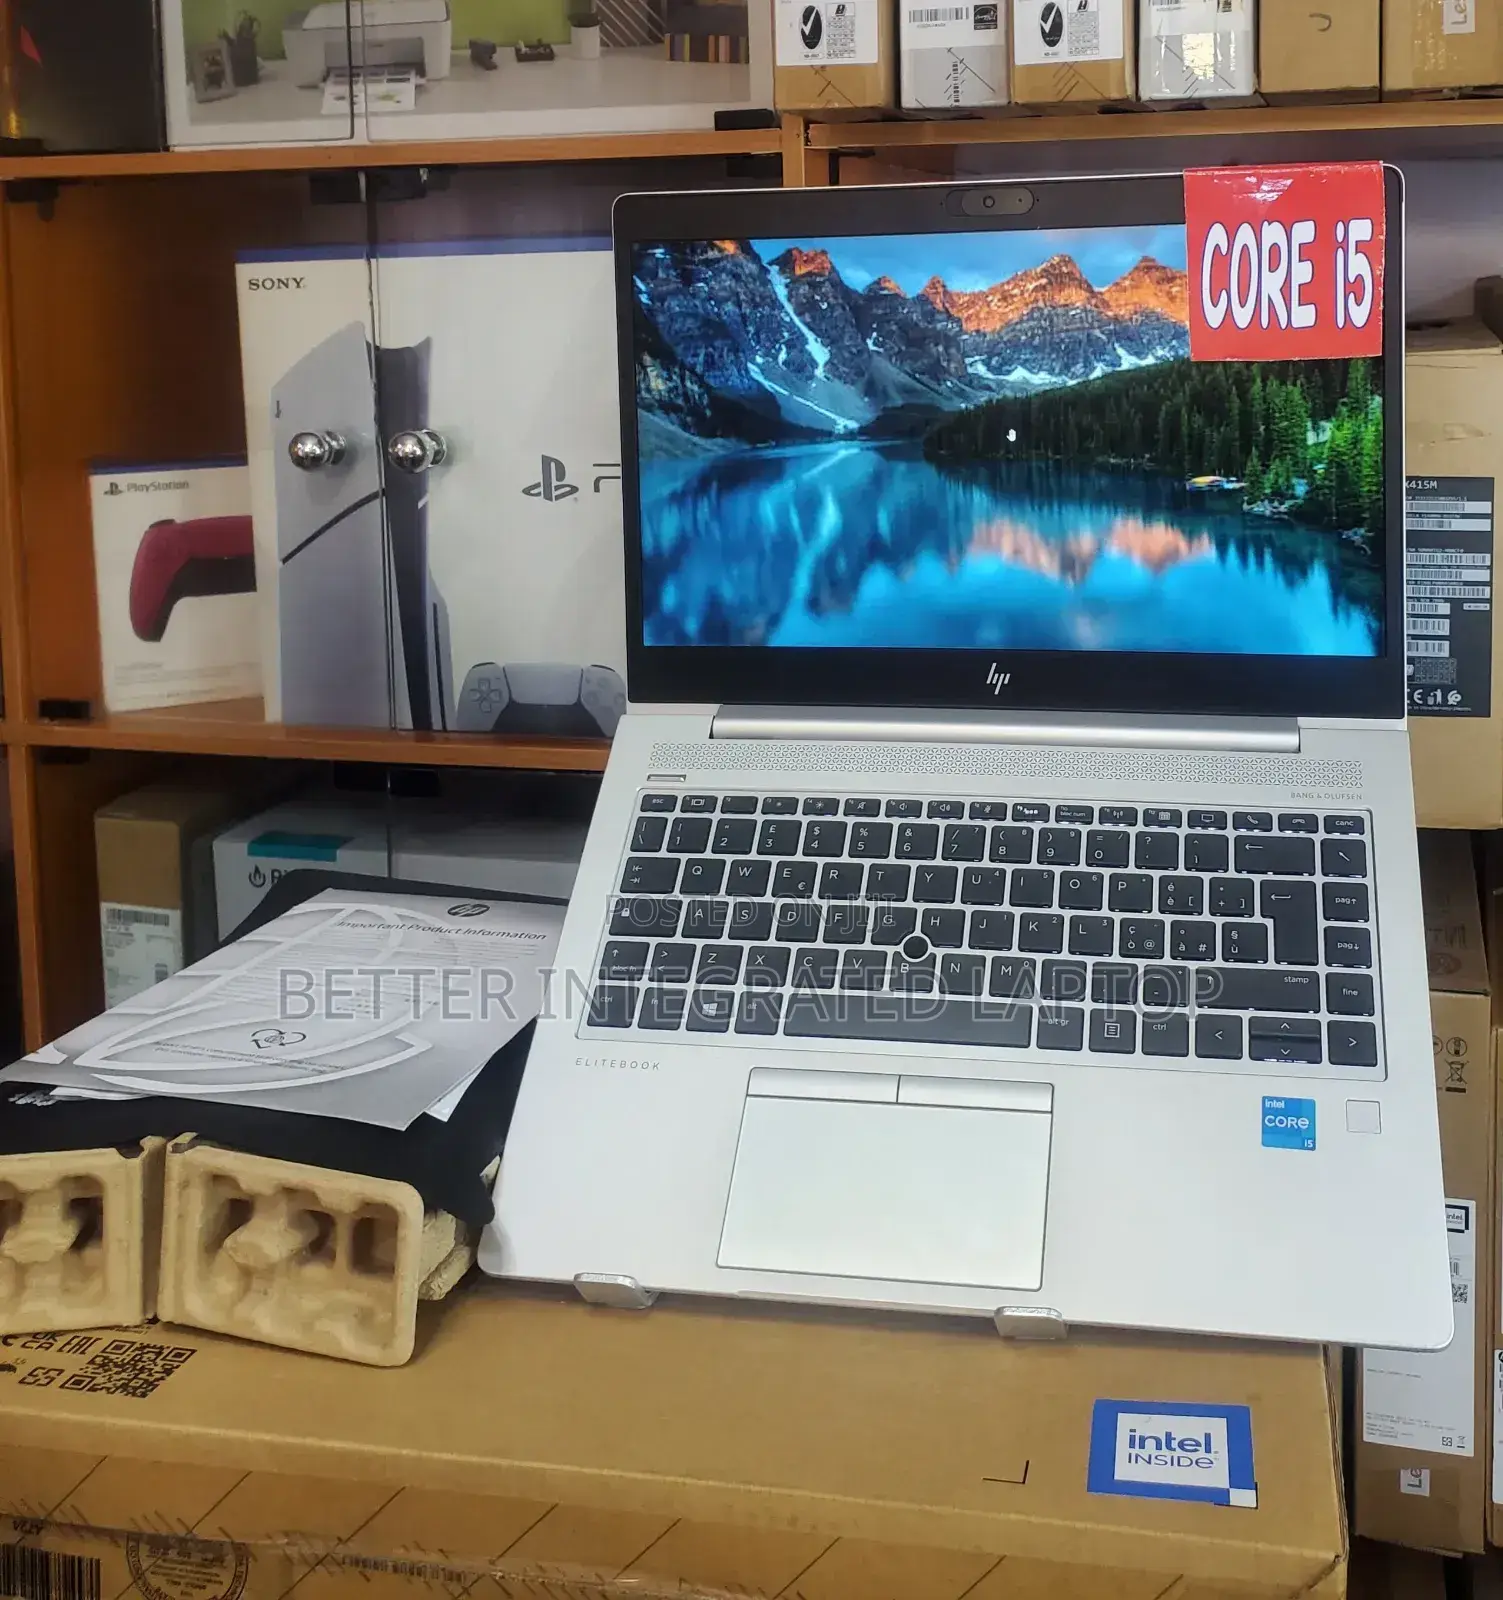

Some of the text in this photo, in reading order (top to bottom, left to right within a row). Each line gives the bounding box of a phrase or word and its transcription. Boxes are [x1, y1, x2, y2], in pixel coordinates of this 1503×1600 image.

[1202, 218, 1374, 330] CORE i5
[248, 277, 305, 291] SONY
[127, 480, 190, 493] PlayStation
[986, 662, 1011, 695] hp
[1323, 792, 1363, 800] OLUFSEN
[720, 837, 728, 846] 2
[765, 839, 773, 847] 3
[811, 840, 819, 848] 4
[857, 842, 865, 850] 5
[903, 843, 911, 851] 6
[951, 844, 958, 853] 7
[998, 846, 1006, 855] 8
[1047, 848, 1054, 857] 9
[692, 865, 703, 875] Q
[738, 866, 752, 877] W
[782, 868, 792, 878] E
[829, 870, 839, 880] R
[876, 871, 885, 881] T
[924, 872, 933, 883] Y
[971, 875, 982, 885] U
[1118, 881, 1127, 891] P
[1335, 896, 1350, 905] pag
[693, 909, 704, 919] A
[740, 909, 749, 920] S
[787, 911, 797, 921] D
[834, 913, 844, 923] F
[883, 914, 894, 924] G
[930, 916, 940, 926] H
[979, 919, 987, 929] J
[337, 921, 547, 940] Important Product Information
[1029, 921, 1039, 932] K
[1079, 924, 1087, 934] L
[1143, 940, 1155, 949] @
[1198, 943, 1207, 952] #
[1337, 941, 1353, 950] pag
[707, 953, 717, 963] Z
[755, 954, 765, 965] X
[803, 956, 814, 966] C
[852, 958, 863, 968] V
[900, 963, 910, 973] B
[950, 963, 961, 973] N
[1000, 965, 1013, 976] M
[1284, 975, 1309, 984] stamp
[1342, 988, 1358, 996] fine
[1152, 1023, 1167, 1031] ctrl
[575, 1057, 660, 1070] ELITEBOOK
[1265, 1099, 1286, 1109] intel
[1304, 1139, 1314, 1148] i5
[1128, 1429, 1213, 1454] intel
